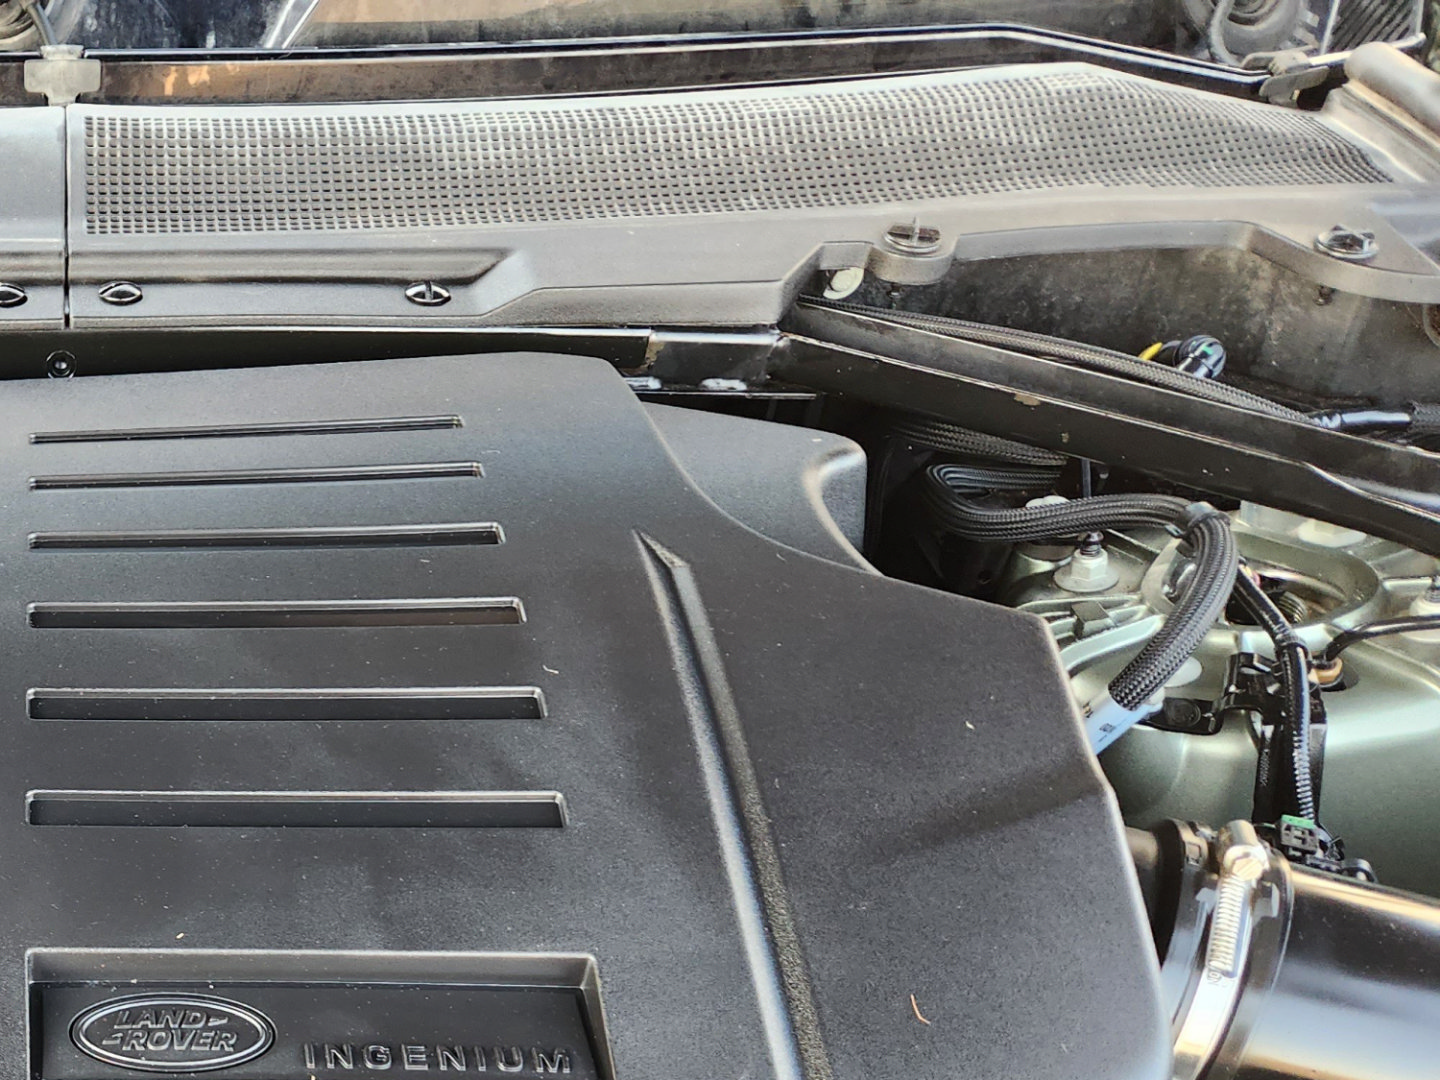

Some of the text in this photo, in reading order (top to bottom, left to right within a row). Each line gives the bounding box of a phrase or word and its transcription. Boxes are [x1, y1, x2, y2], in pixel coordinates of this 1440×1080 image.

[114, 1010, 206, 1029] LAND
[122, 1029, 237, 1051] ROVER
[303, 1043, 572, 1074] INGENIUM
